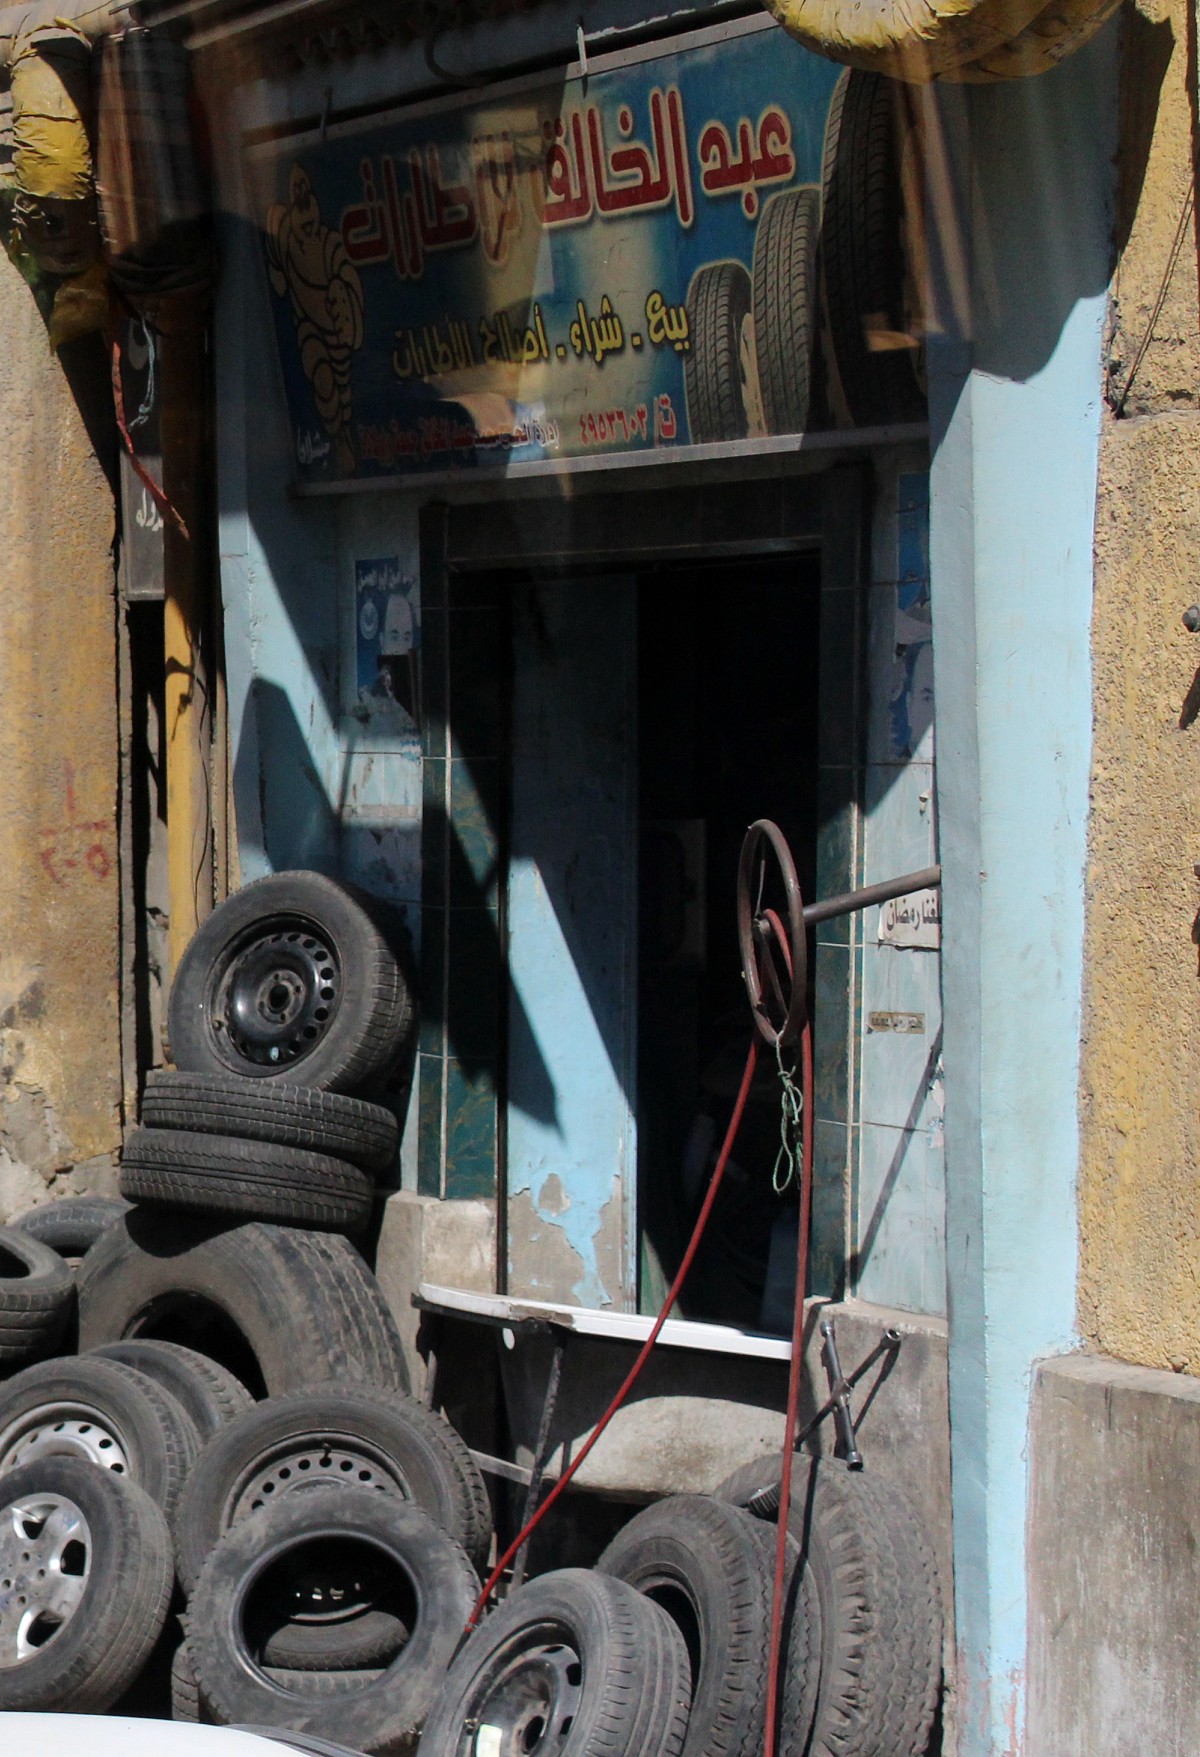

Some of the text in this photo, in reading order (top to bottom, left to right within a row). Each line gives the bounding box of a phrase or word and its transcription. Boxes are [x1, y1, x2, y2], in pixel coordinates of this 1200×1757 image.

[701, 106, 795, 218] عبد
[569, 295, 623, 361] شراء
[645, 291, 691, 350] بيع
[886, 897, 920, 931] رمضان
